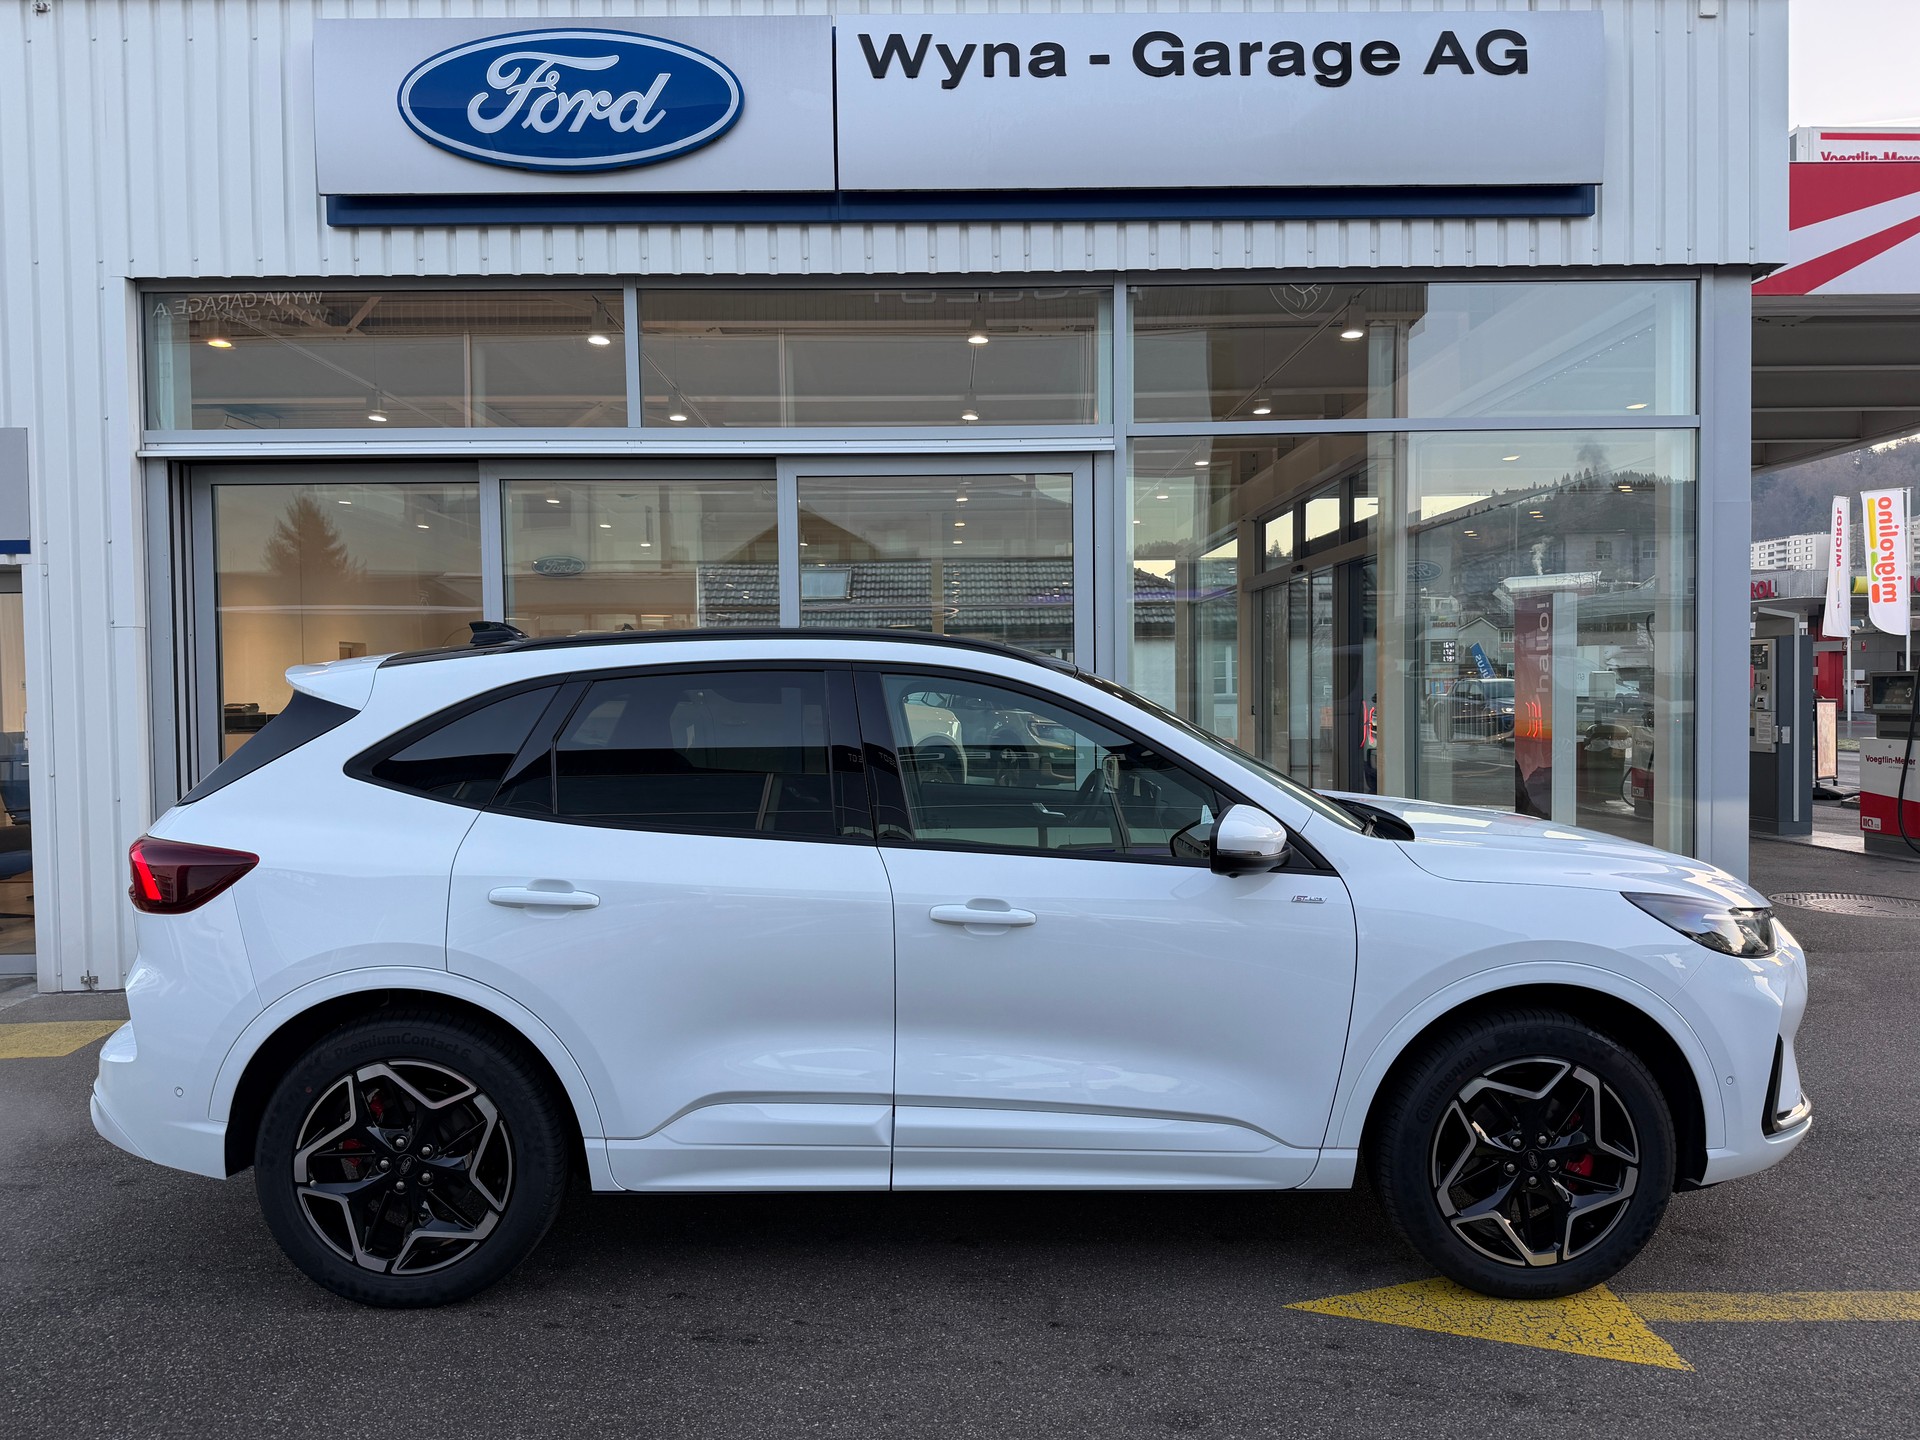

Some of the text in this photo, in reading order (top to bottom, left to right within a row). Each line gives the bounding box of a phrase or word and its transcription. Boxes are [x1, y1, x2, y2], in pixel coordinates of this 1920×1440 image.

[467, 51, 671, 133] Ford
[857, 29, 1528, 89] Wyna - Garage AG
[1875, 496, 1903, 603] migrolino
[1536, 602, 1550, 693] hallo!
[1865, 754, 1916, 766] Voegtlin-Meer
[334, 1032, 459, 1058] PremiumContact
